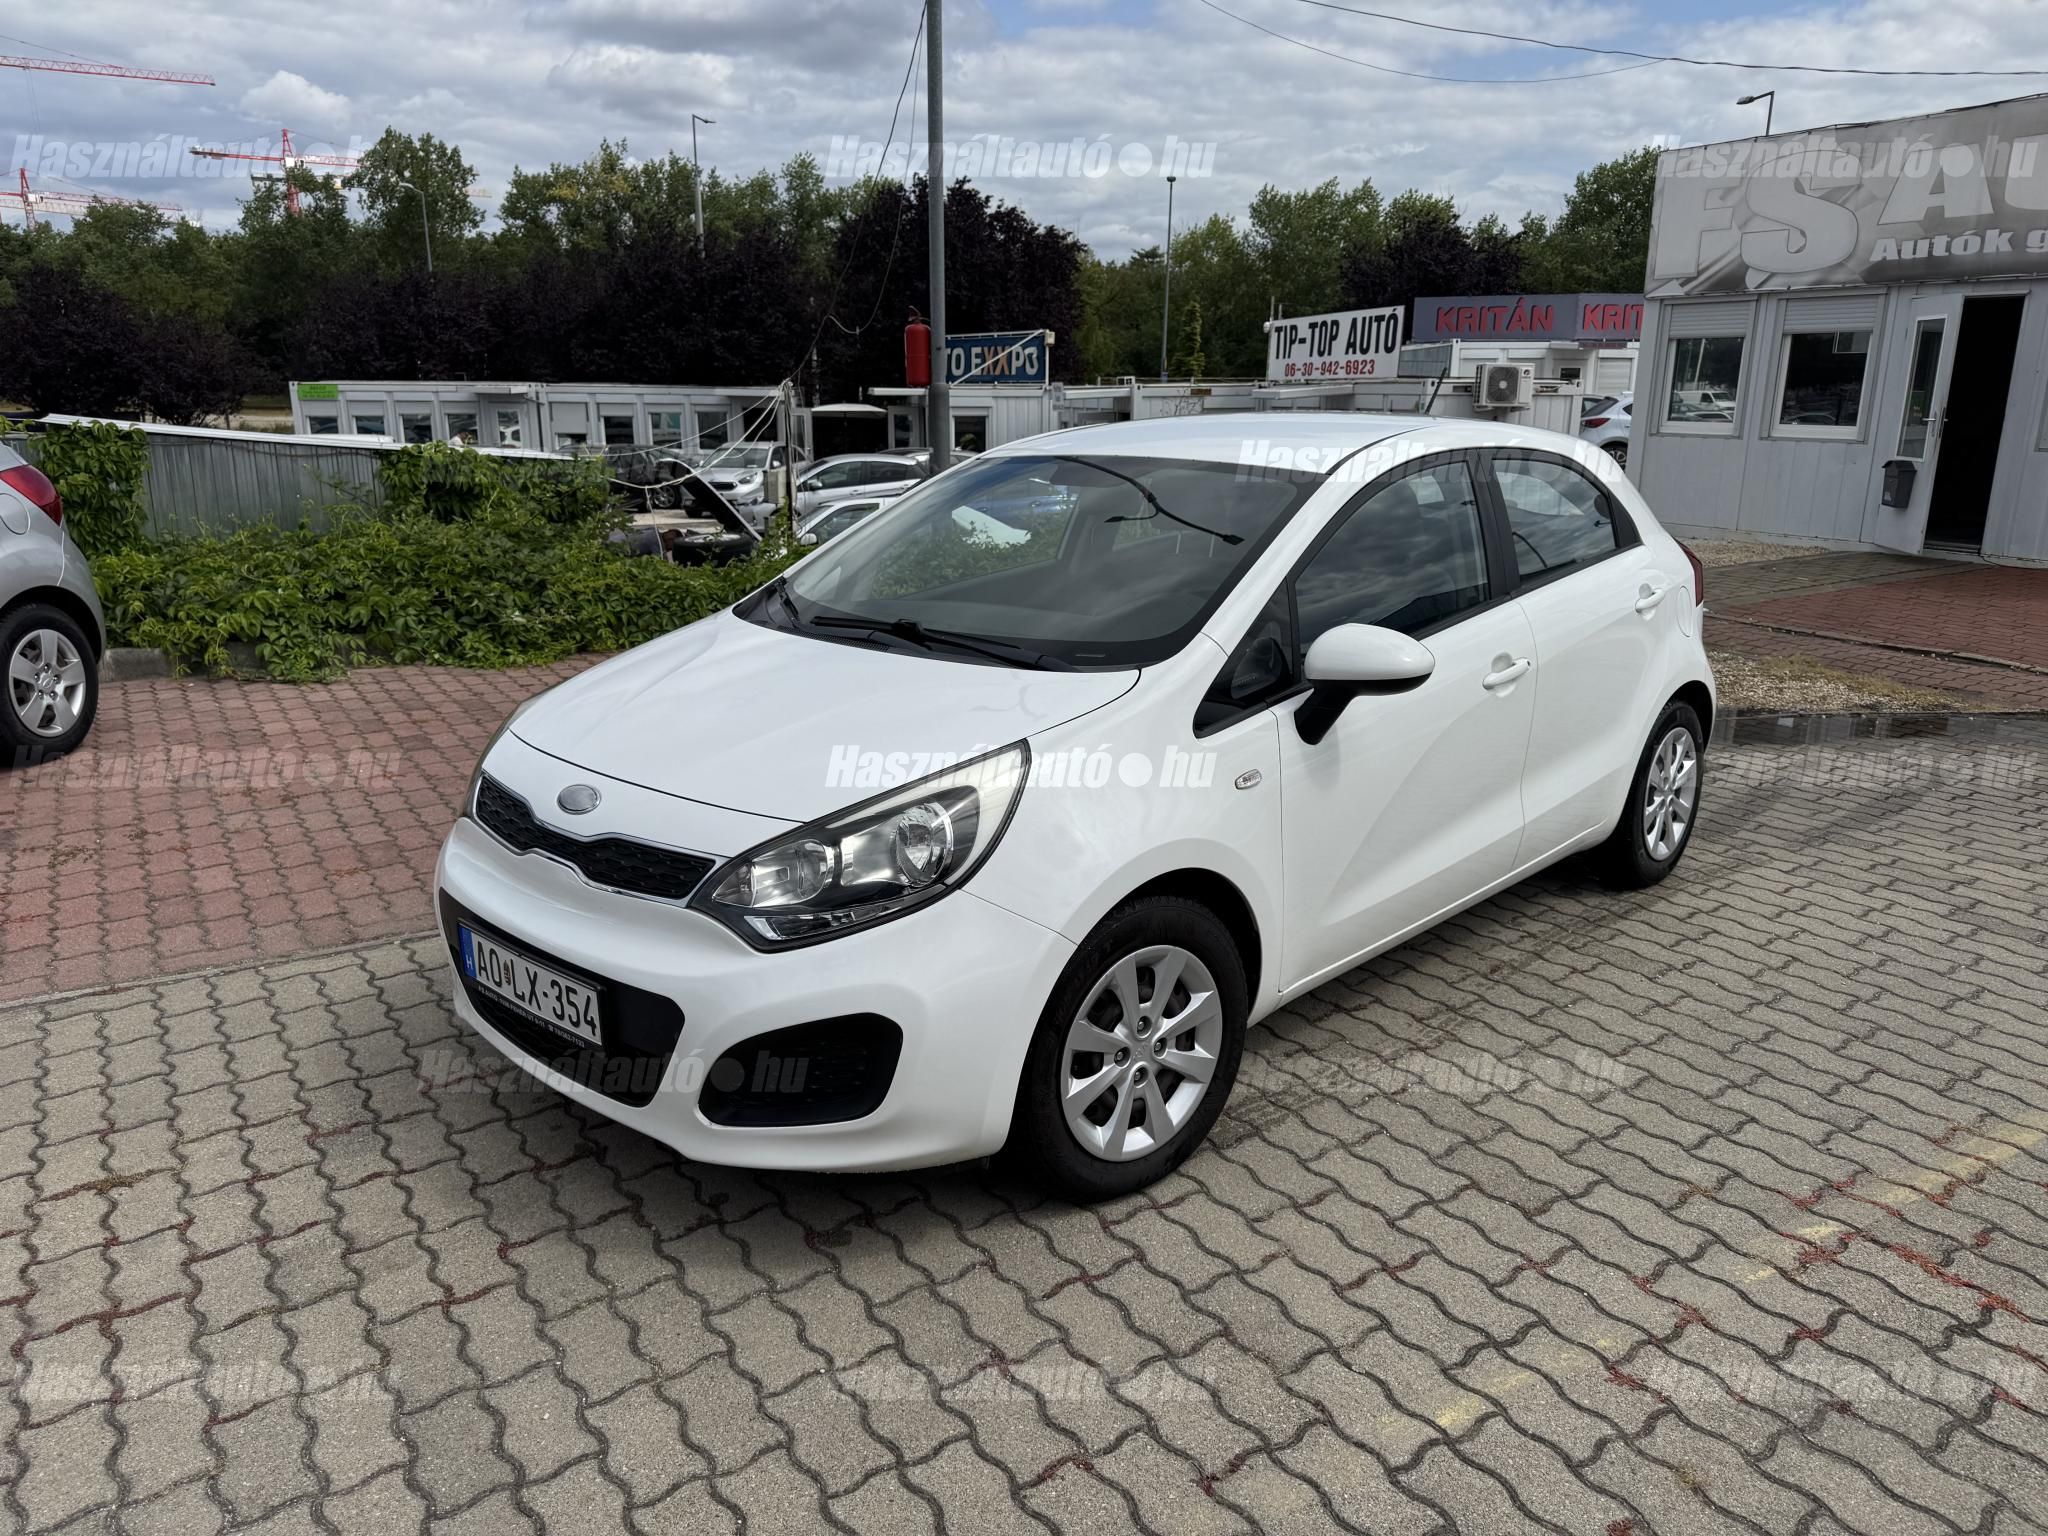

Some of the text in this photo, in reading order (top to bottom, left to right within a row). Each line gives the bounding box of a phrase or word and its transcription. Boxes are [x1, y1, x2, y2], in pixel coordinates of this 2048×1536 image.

[1869, 229, 2014, 262] Autók
[1436, 297, 1555, 335] KRITÁN
[1275, 308, 1399, 360] TIP-TOP AUTÓ
[1285, 359, 1376, 377] 06-30-942-6923
[466, 954, 474, 970] H
